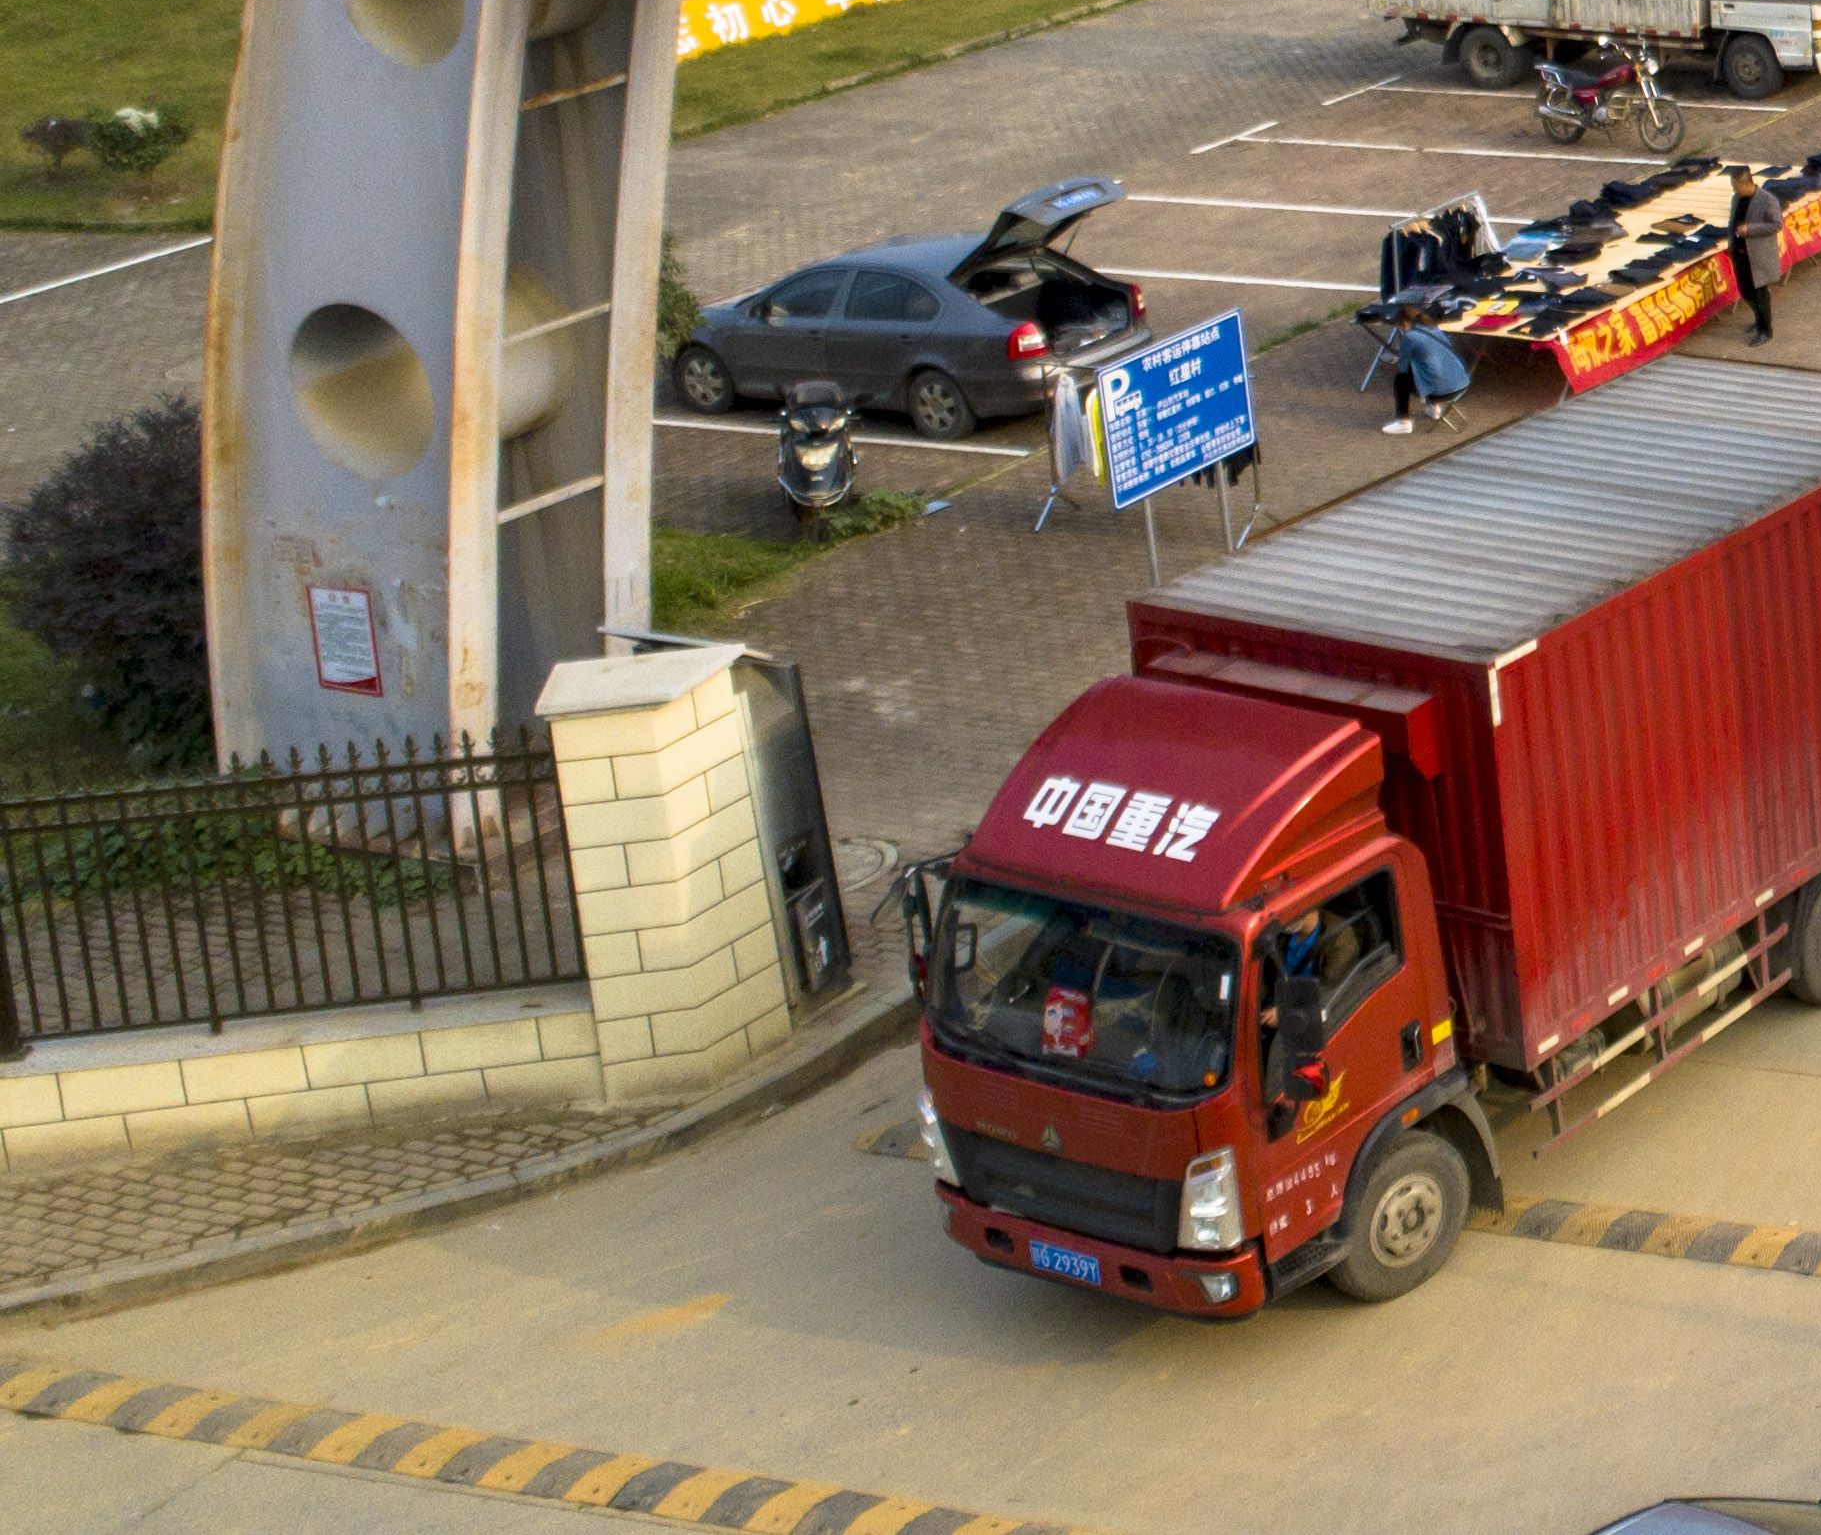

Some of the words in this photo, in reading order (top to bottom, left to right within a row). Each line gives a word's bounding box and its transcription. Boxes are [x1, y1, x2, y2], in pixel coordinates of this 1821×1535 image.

[1102, 368, 1130, 421] P
[1023, 776, 1221, 862] 中国重汽
